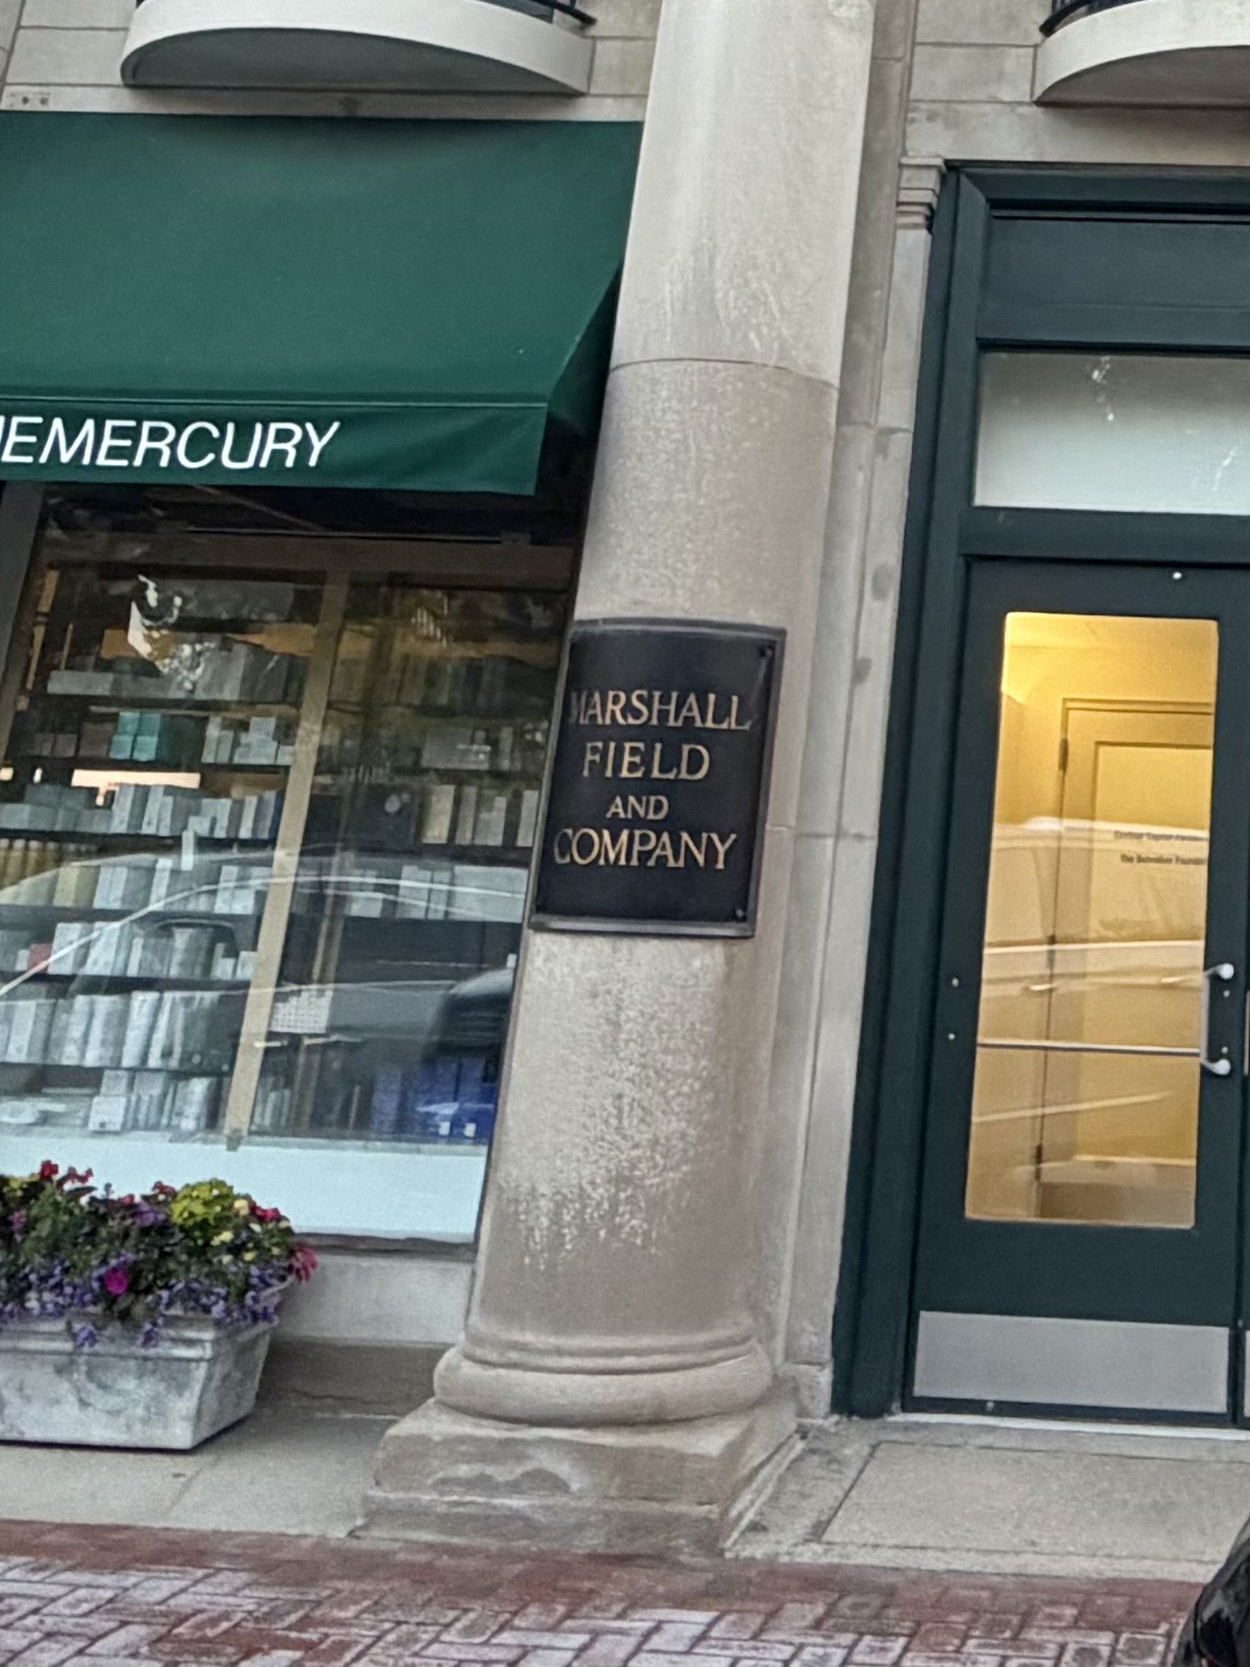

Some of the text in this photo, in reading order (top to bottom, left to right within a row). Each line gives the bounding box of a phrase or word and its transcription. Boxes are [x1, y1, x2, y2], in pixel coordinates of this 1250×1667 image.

[0, 415, 341, 470] EMERCURY
[582, 740, 711, 781] FIELD
[605, 795, 670, 821] AND
[553, 827, 737, 870] COMPANY
